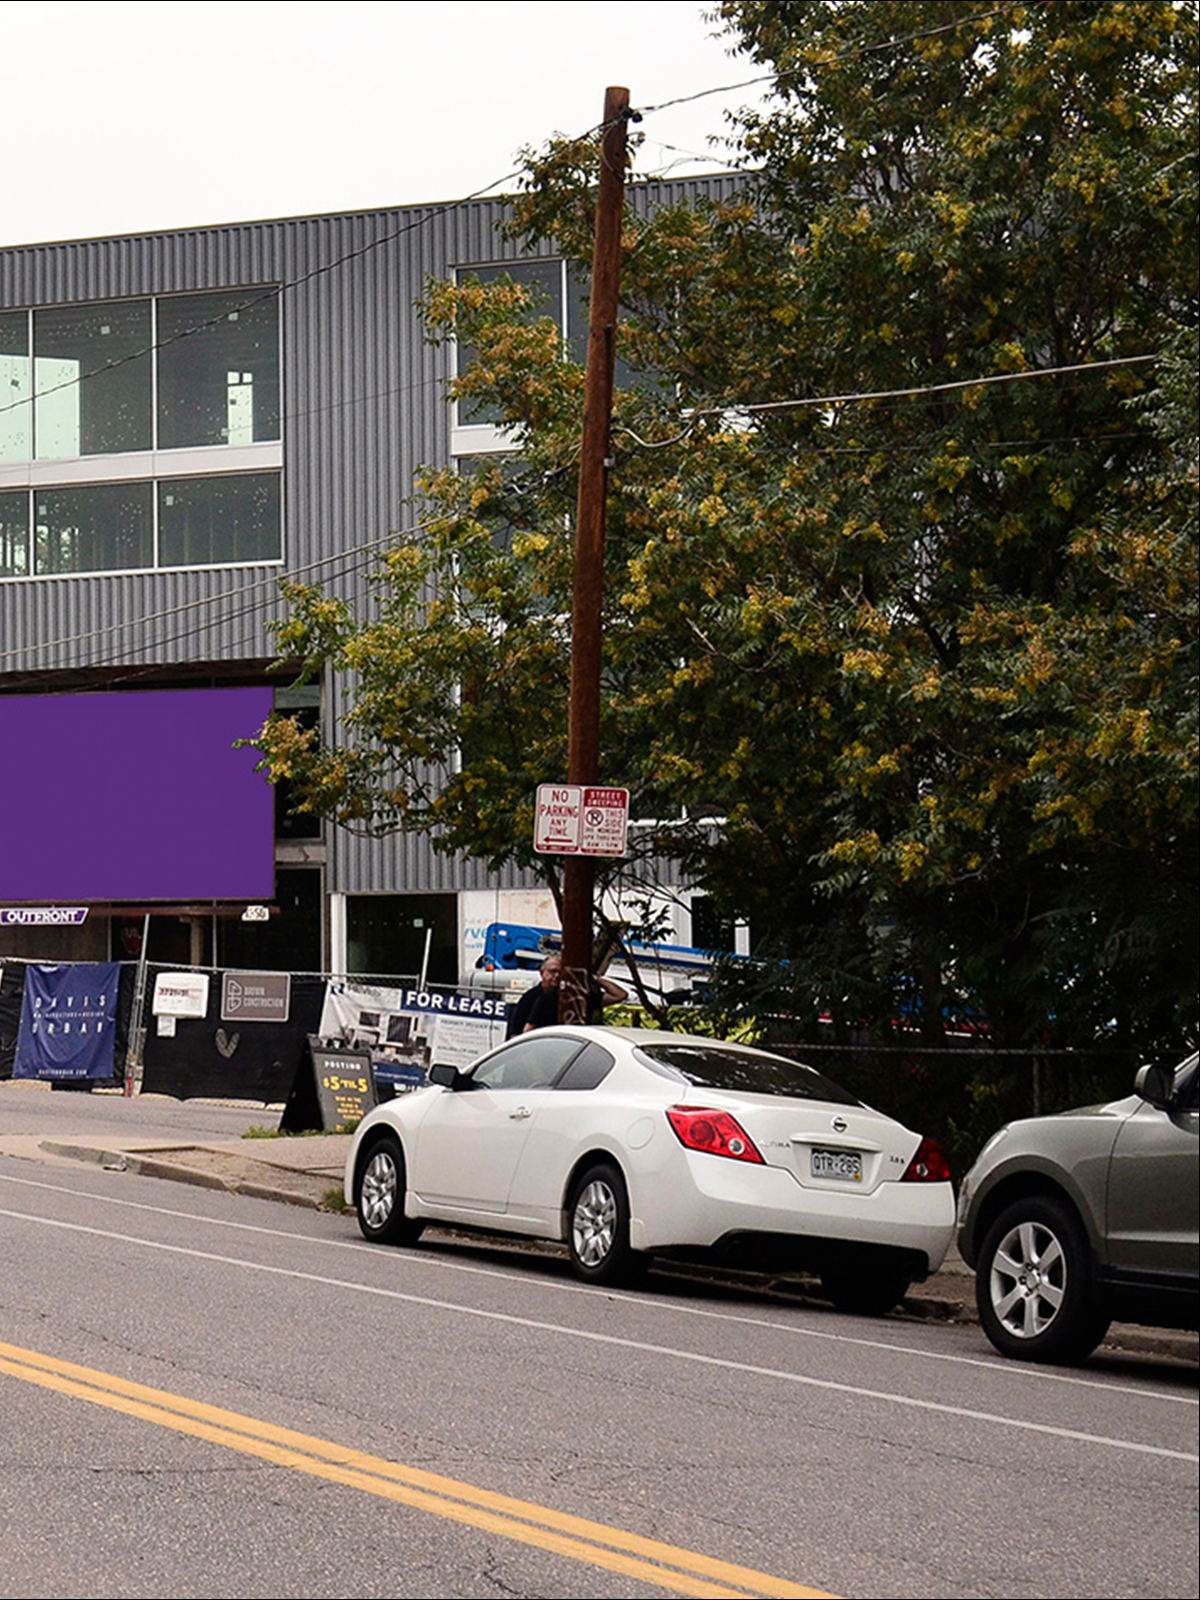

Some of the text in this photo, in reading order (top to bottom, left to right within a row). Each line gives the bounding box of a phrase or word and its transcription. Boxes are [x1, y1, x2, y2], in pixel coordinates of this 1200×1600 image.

[551, 790, 569, 803] NO
[590, 791, 621, 799] STREET
[540, 805, 579, 818] PARKING
[551, 818, 567, 826] ANY
[549, 827, 568, 836] TIME
[7, 910, 79, 923] OUTFRONT
[35, 995, 106, 1008] DAVIS
[406, 991, 507, 1016] FOR LEASE
[32, 1022, 103, 1034] URBAN
